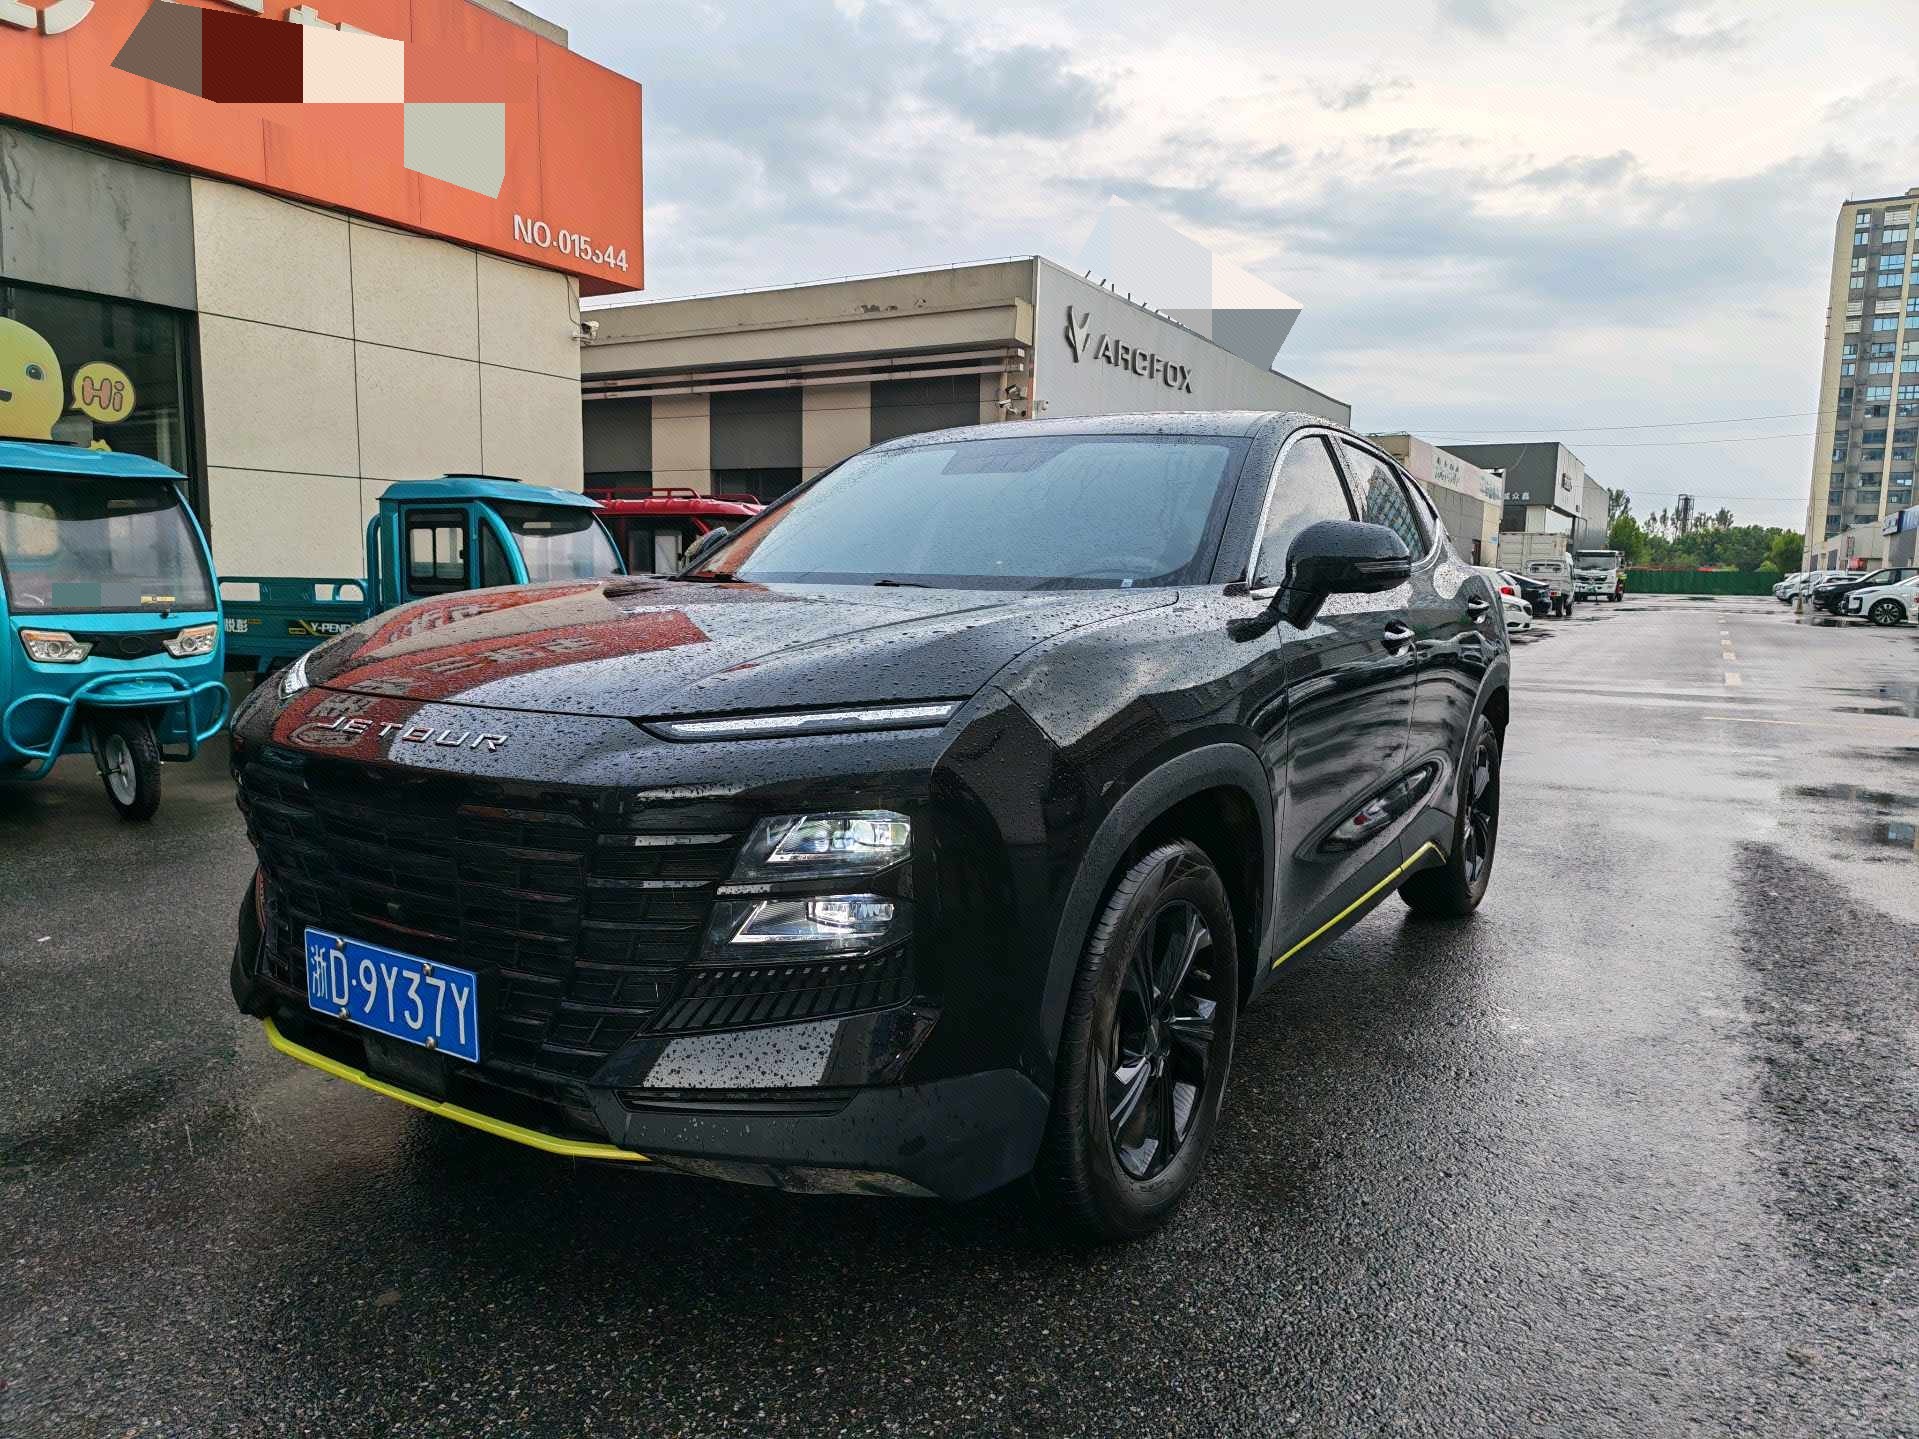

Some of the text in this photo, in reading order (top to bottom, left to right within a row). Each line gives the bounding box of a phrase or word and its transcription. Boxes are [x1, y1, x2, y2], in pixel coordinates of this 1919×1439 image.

[1093, 333, 1192, 394] ARCFOX
[82, 375, 125, 412] Hi
[317, 715, 509, 752] JETOUR
[310, 944, 471, 1045] 浙D·9Y37Y
